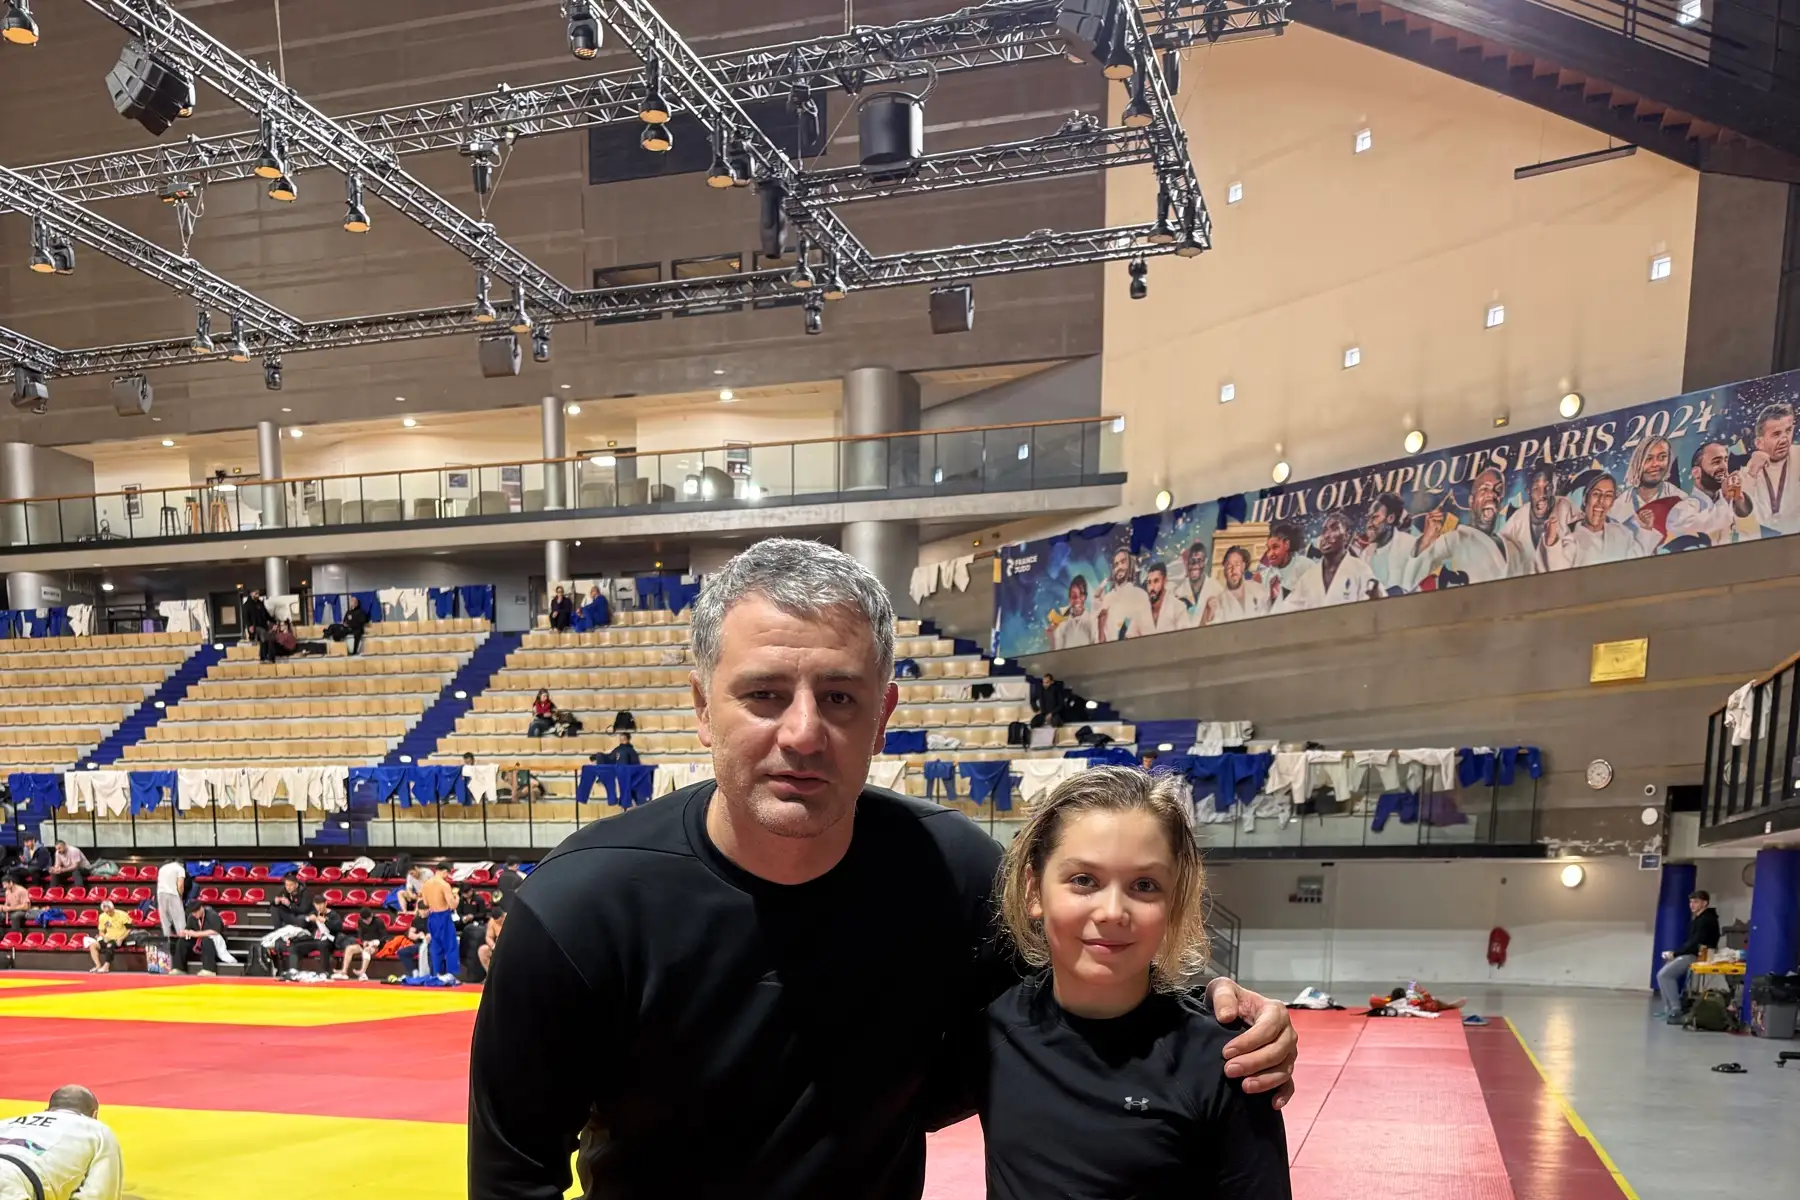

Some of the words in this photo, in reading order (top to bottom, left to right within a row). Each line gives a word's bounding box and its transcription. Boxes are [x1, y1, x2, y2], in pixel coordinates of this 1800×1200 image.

[1316, 445, 1510, 511] OLYMPIQUES
[1513, 421, 1617, 472] PARIS
[1623, 400, 1714, 448] 2024
[8, 1115, 57, 1127] AZE
